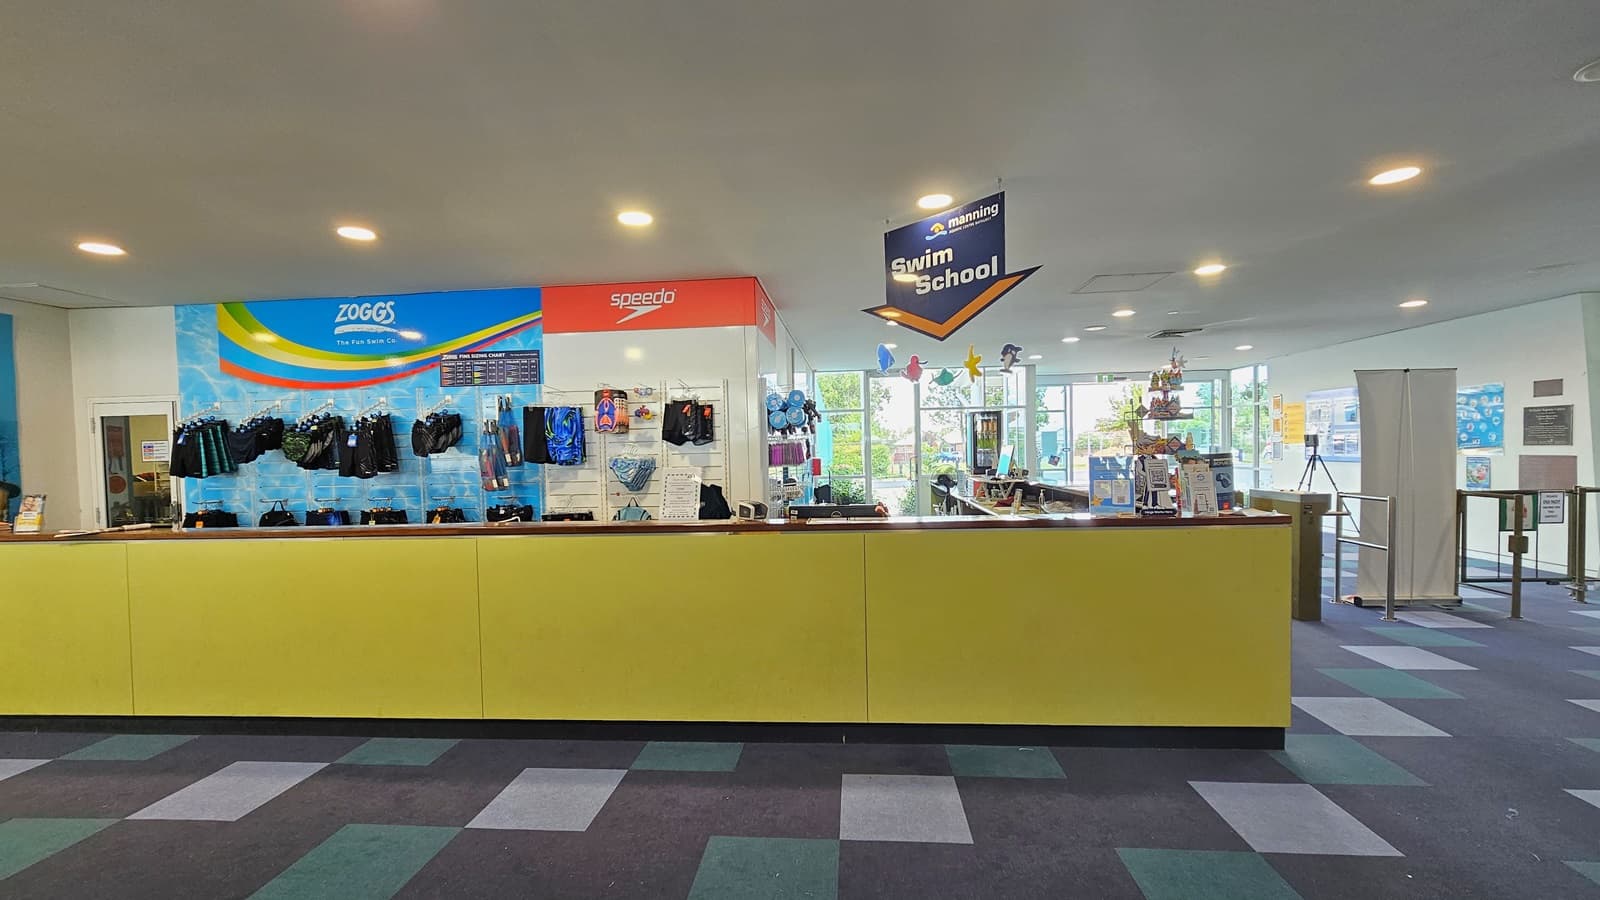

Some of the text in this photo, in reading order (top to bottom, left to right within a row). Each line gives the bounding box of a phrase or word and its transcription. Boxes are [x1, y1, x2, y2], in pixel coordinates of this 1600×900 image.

[948, 203, 999, 228] manning
[891, 247, 953, 277] Swim
[915, 255, 998, 295] School
[610, 288, 675, 309] speedo
[334, 301, 396, 325] ZOGGS
